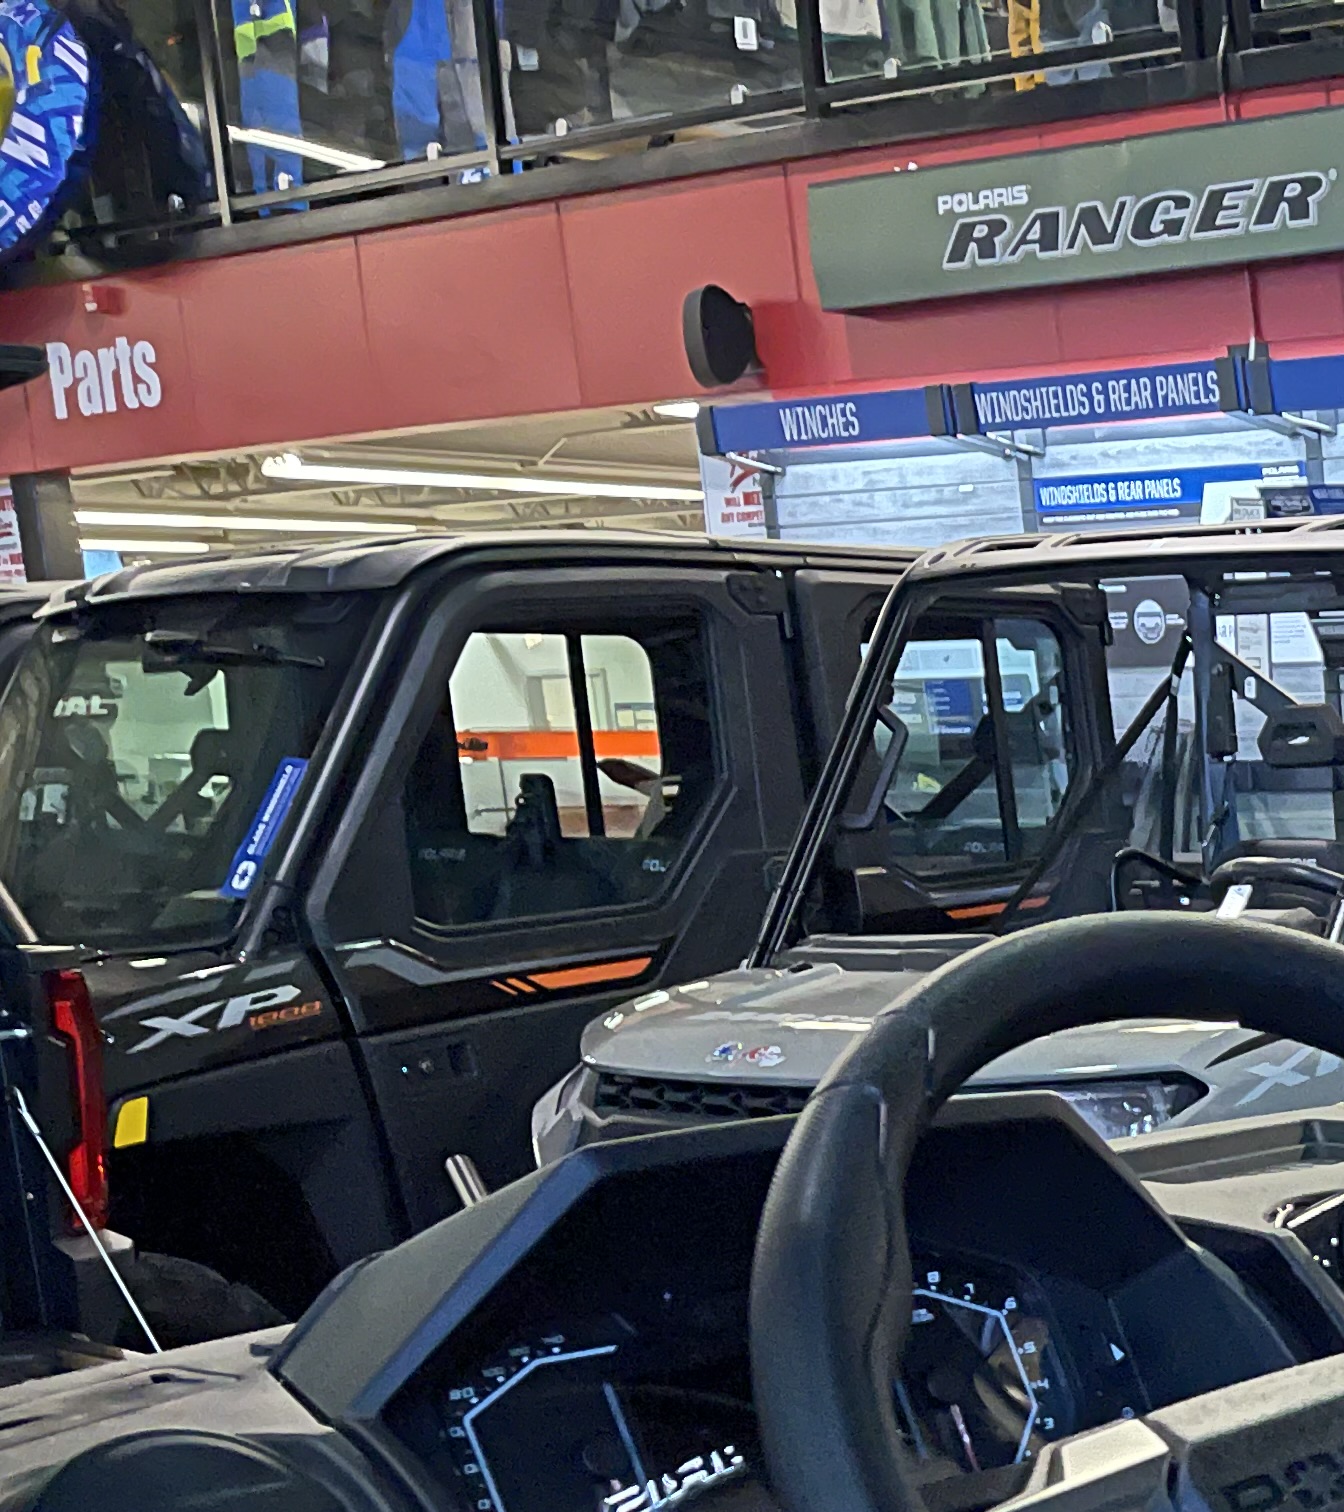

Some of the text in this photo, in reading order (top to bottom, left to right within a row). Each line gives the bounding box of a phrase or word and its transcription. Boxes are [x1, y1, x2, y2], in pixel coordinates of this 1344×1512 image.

[937, 184, 1029, 216] POLARIS
[942, 170, 1328, 271] RANGER
[46, 336, 162, 420] Parts
[974, 370, 1220, 425] WINDSHIELDS & REAR PANELS
[779, 402, 860, 442] WINCHES
[1040, 477, 1182, 506] WINDSHIELDS & REAR PANELS
[126, 985, 302, 1055] XP
